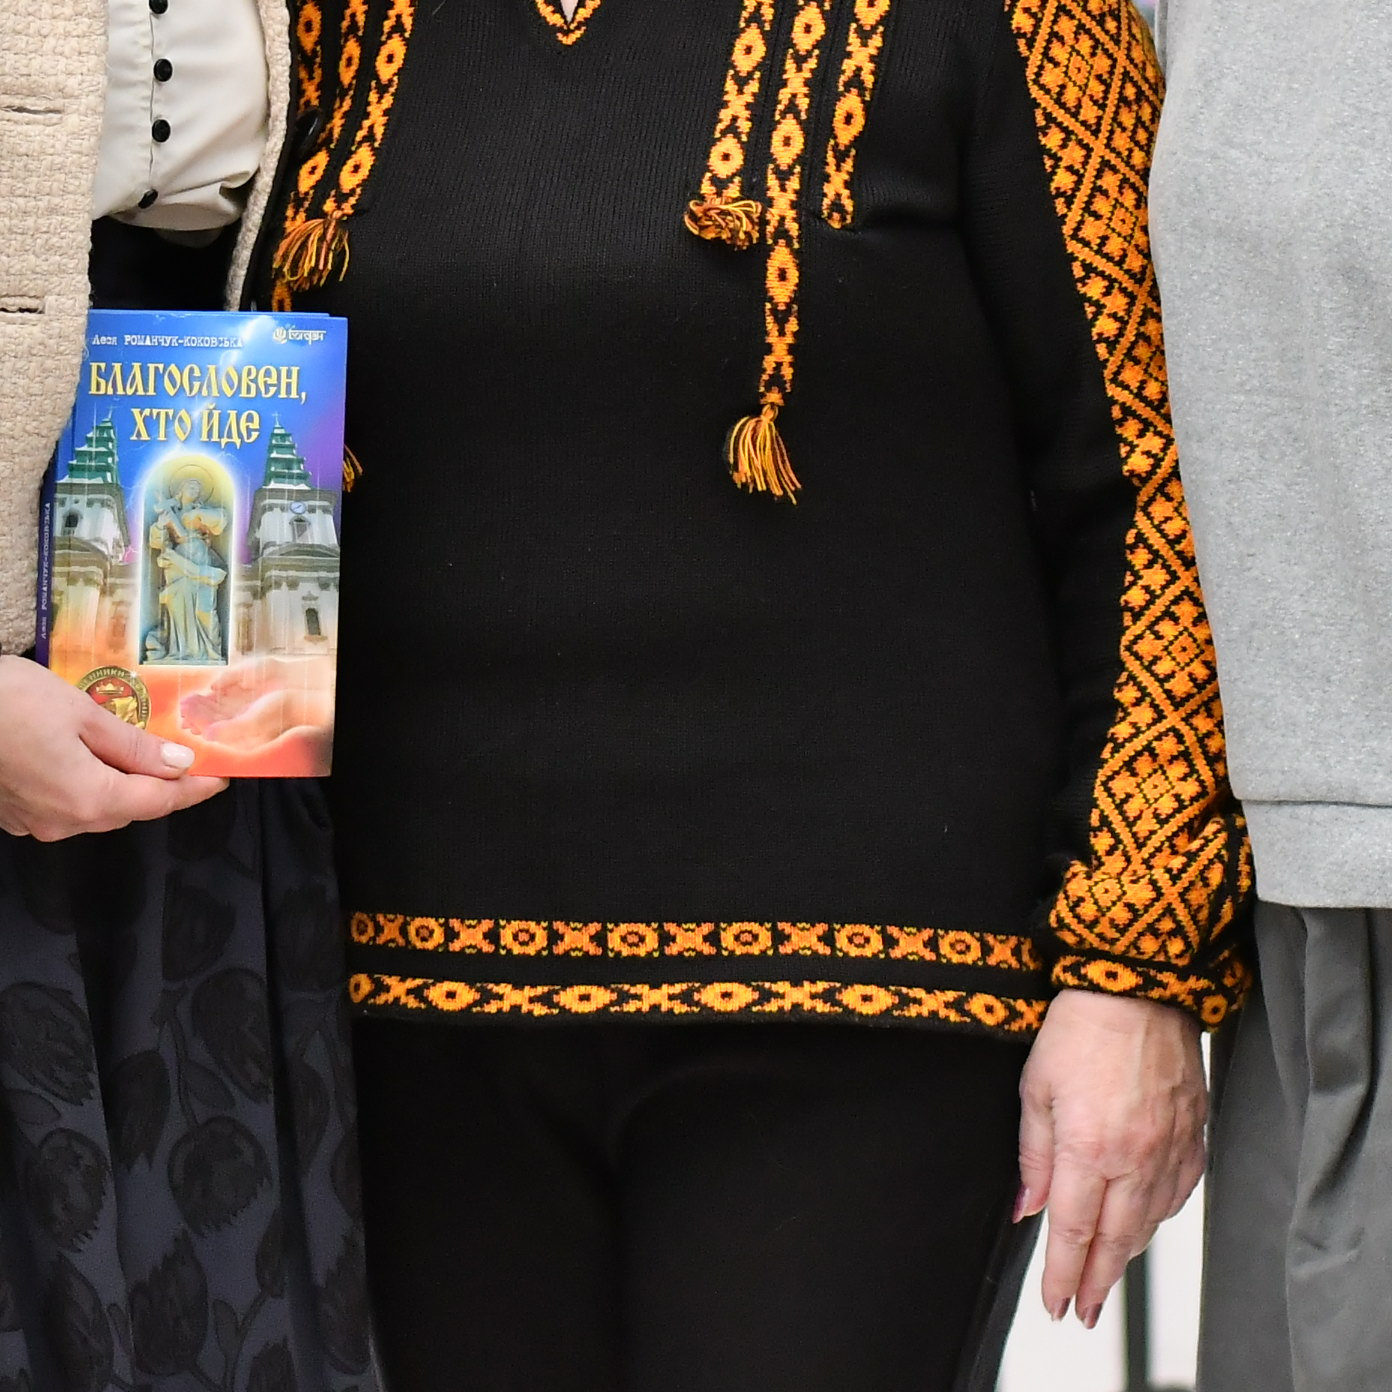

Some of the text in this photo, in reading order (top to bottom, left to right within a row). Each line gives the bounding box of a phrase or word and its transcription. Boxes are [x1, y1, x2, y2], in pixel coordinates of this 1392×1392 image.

[88, 362, 307, 404] БЛАГОСЛОВЕН,
[130, 403, 260, 449] ХТО ЙДЕ
